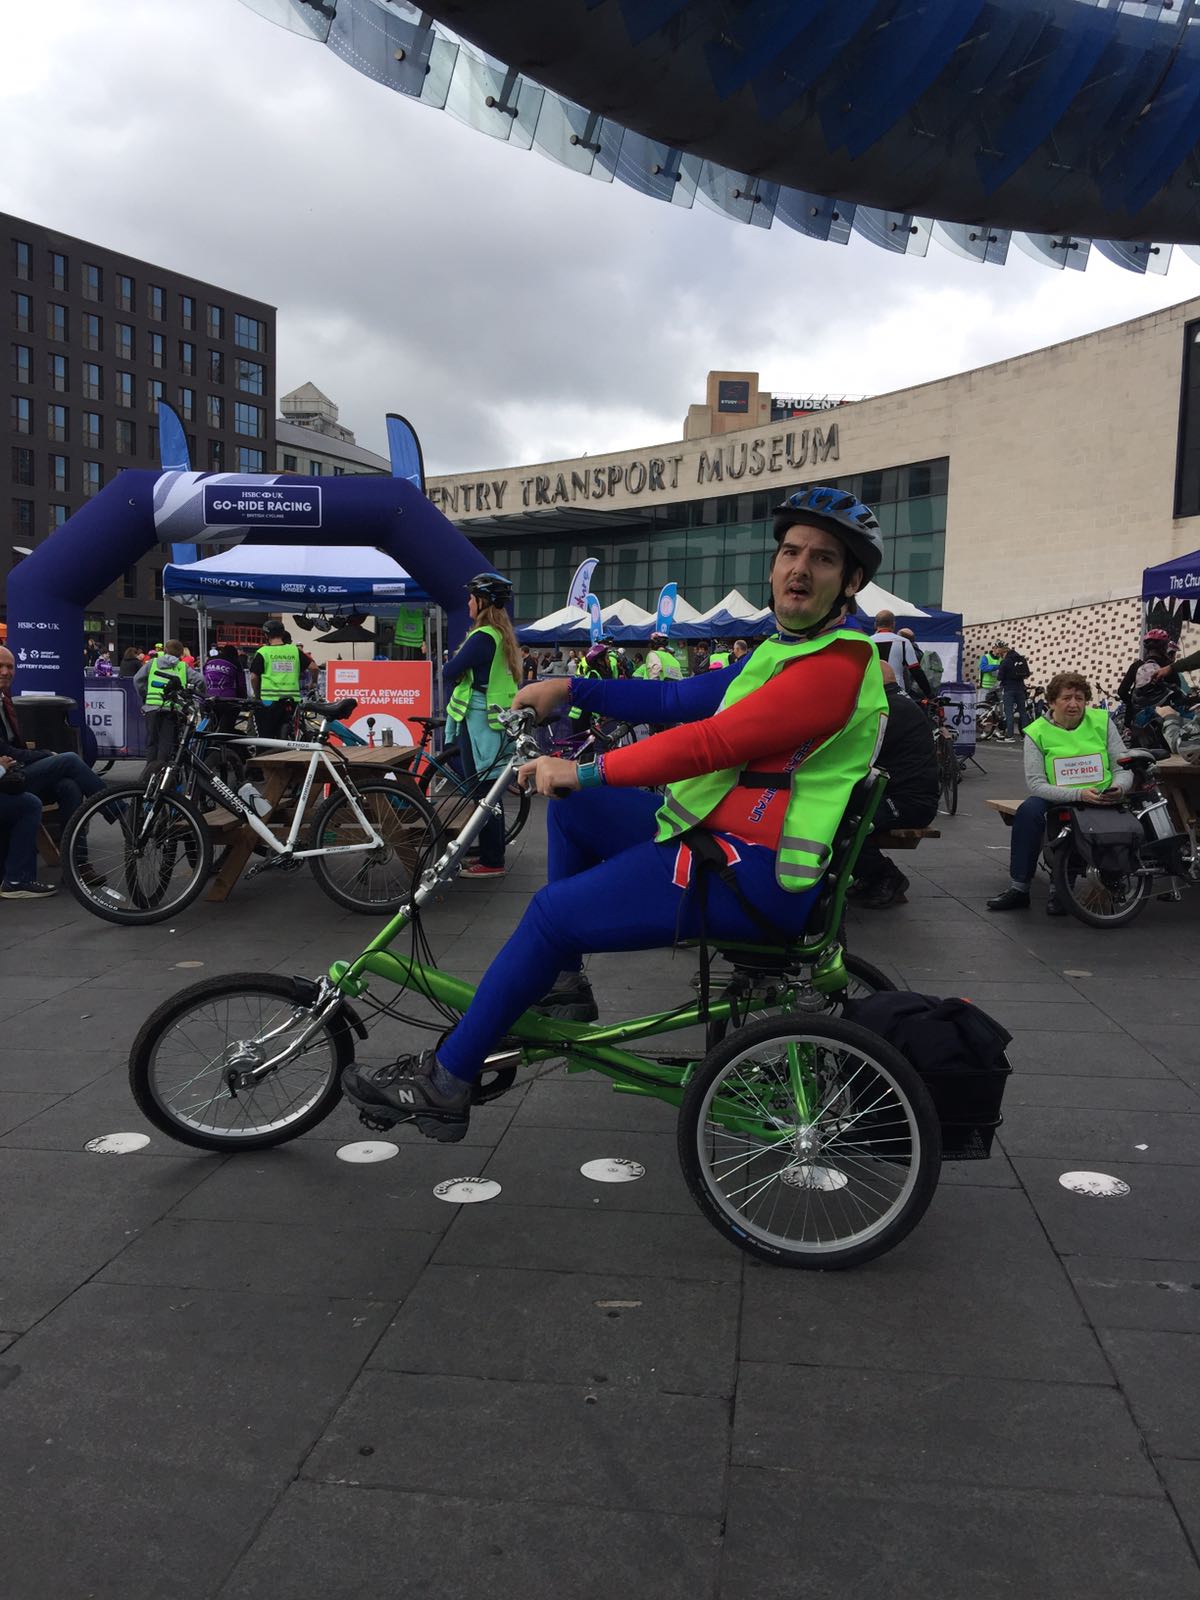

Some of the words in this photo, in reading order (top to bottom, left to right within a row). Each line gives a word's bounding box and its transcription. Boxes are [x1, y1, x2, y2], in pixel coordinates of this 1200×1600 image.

[776, 400, 839, 410] STUDENT
[520, 455, 683, 508] TRANSPORT
[697, 423, 840, 485] MUSEUM
[213, 501, 264, 510] GO-RIDE
[267, 502, 312, 511] RACING
[200, 577, 225, 585] HSBC
[241, 581, 255, 589] UK
[1170, 576, 1183, 589] The
[334, 689, 369, 697] COLLECT
[379, 689, 420, 697] REWARDS
[1081, 765, 1098, 774] RIDE
[399, 1089, 414, 1103] N
